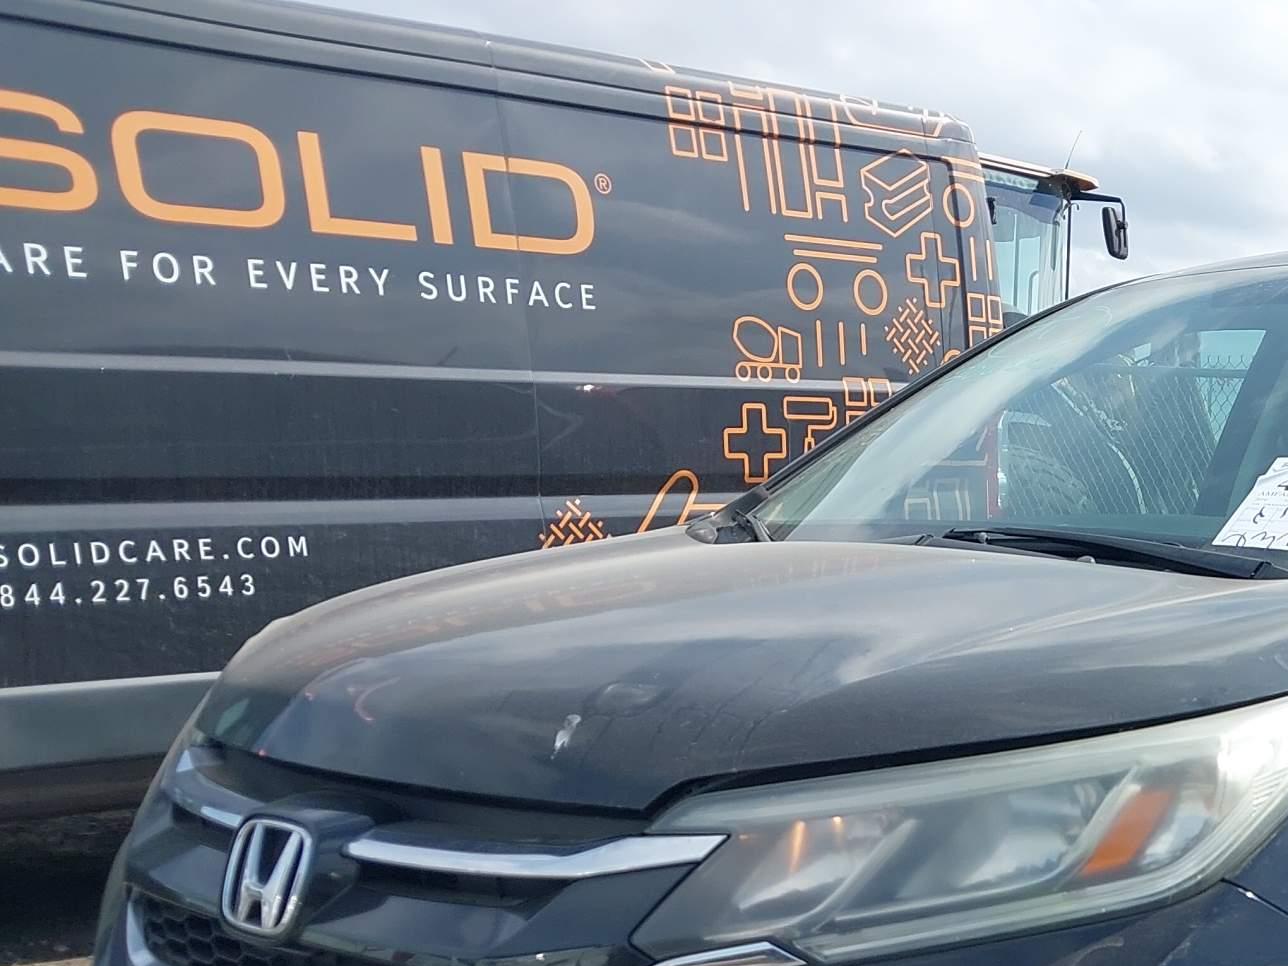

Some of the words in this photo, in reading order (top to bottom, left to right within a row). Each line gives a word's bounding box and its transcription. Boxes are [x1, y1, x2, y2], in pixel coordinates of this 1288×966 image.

[119, 250, 217, 286] FOR
[247, 258, 389, 296] EVERY
[418, 271, 597, 310] SURFACE
[0, 574, 256, 608] 844.227.6543
